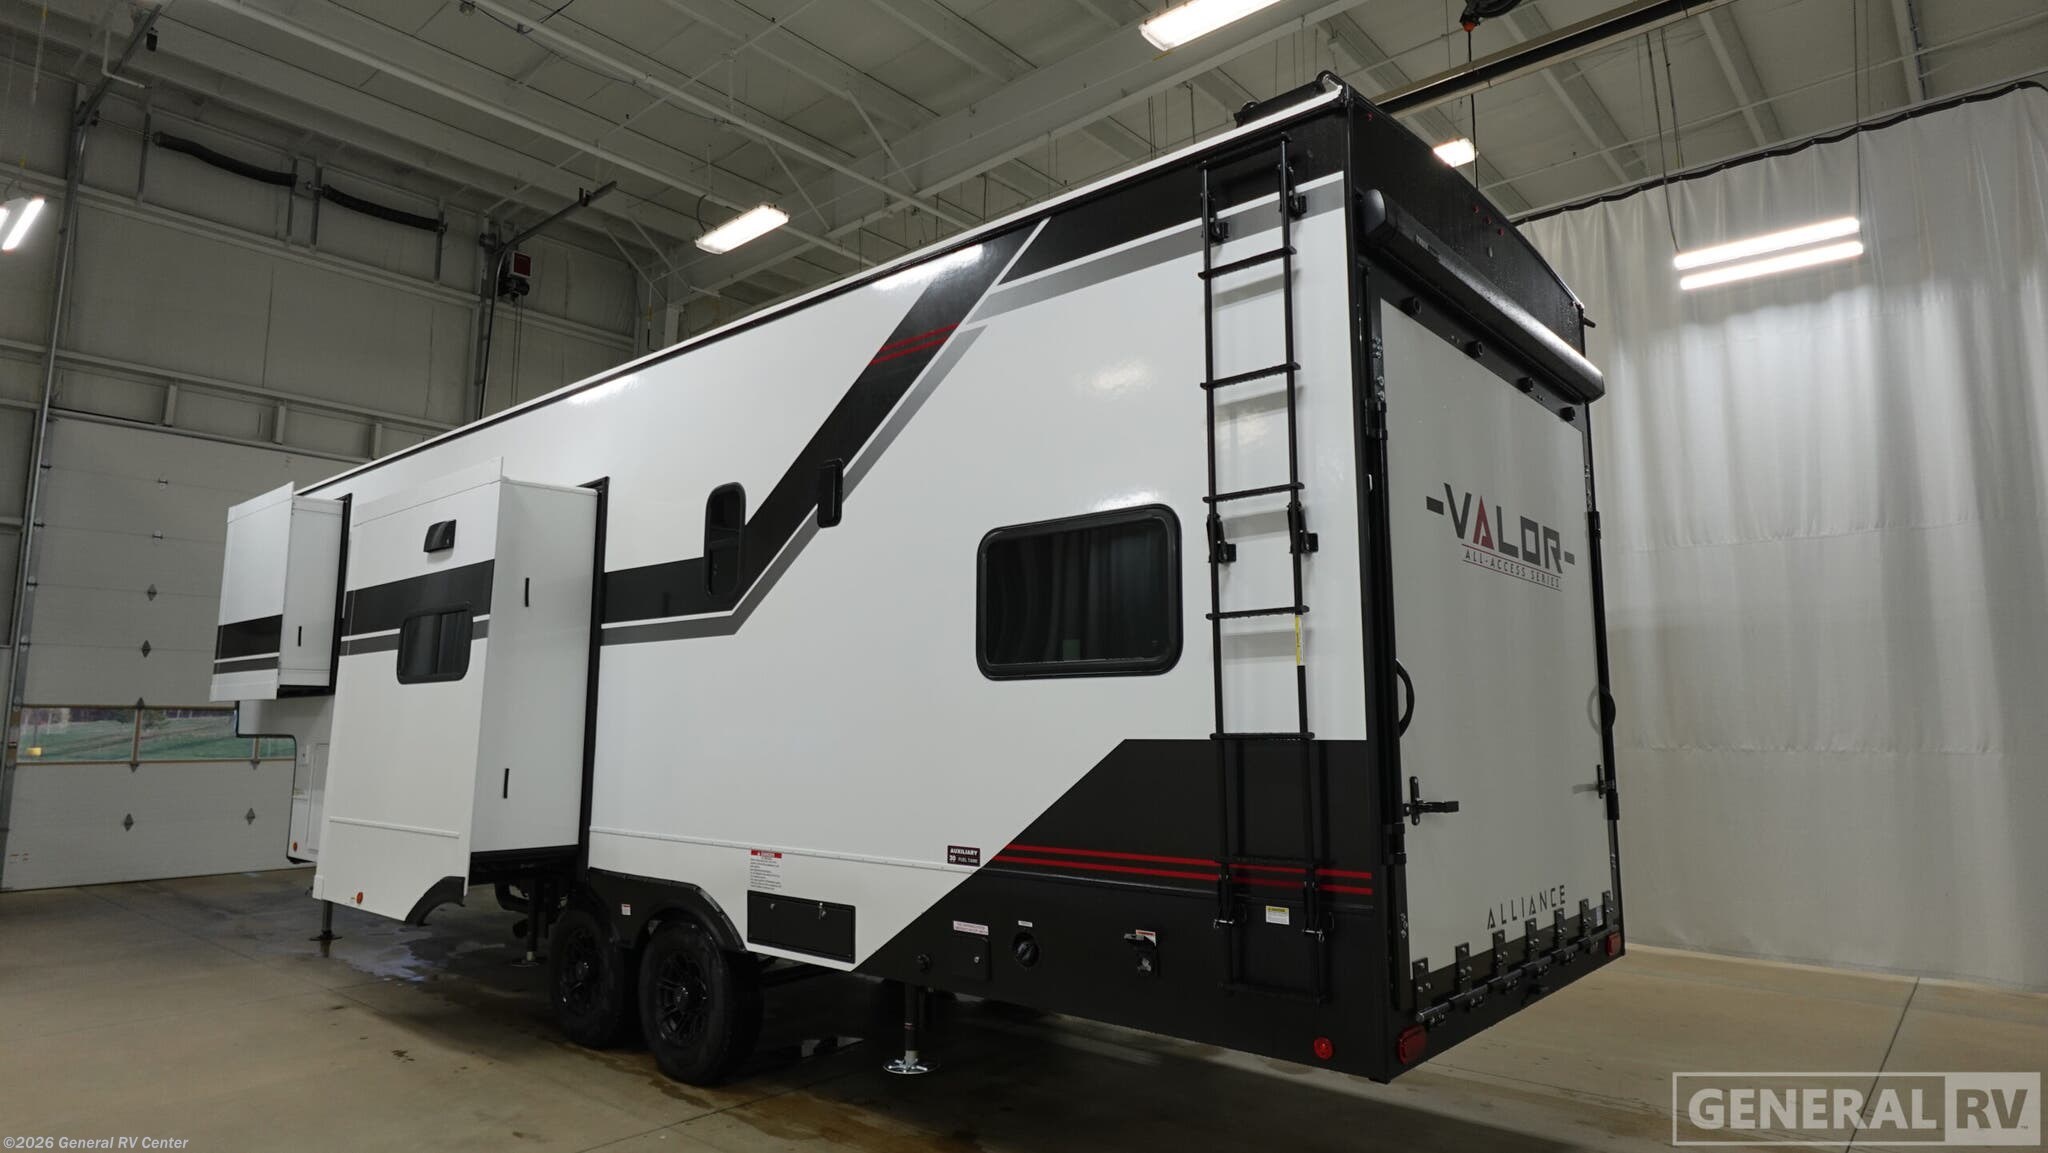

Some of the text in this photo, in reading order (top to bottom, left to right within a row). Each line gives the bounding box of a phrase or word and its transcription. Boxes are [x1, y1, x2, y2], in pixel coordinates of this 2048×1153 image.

[1465, 550, 1560, 588] ALL-ACCESS SERIES
[950, 848, 978, 856] AUXILIARY
[1487, 884, 1566, 930] ALLIANCE
